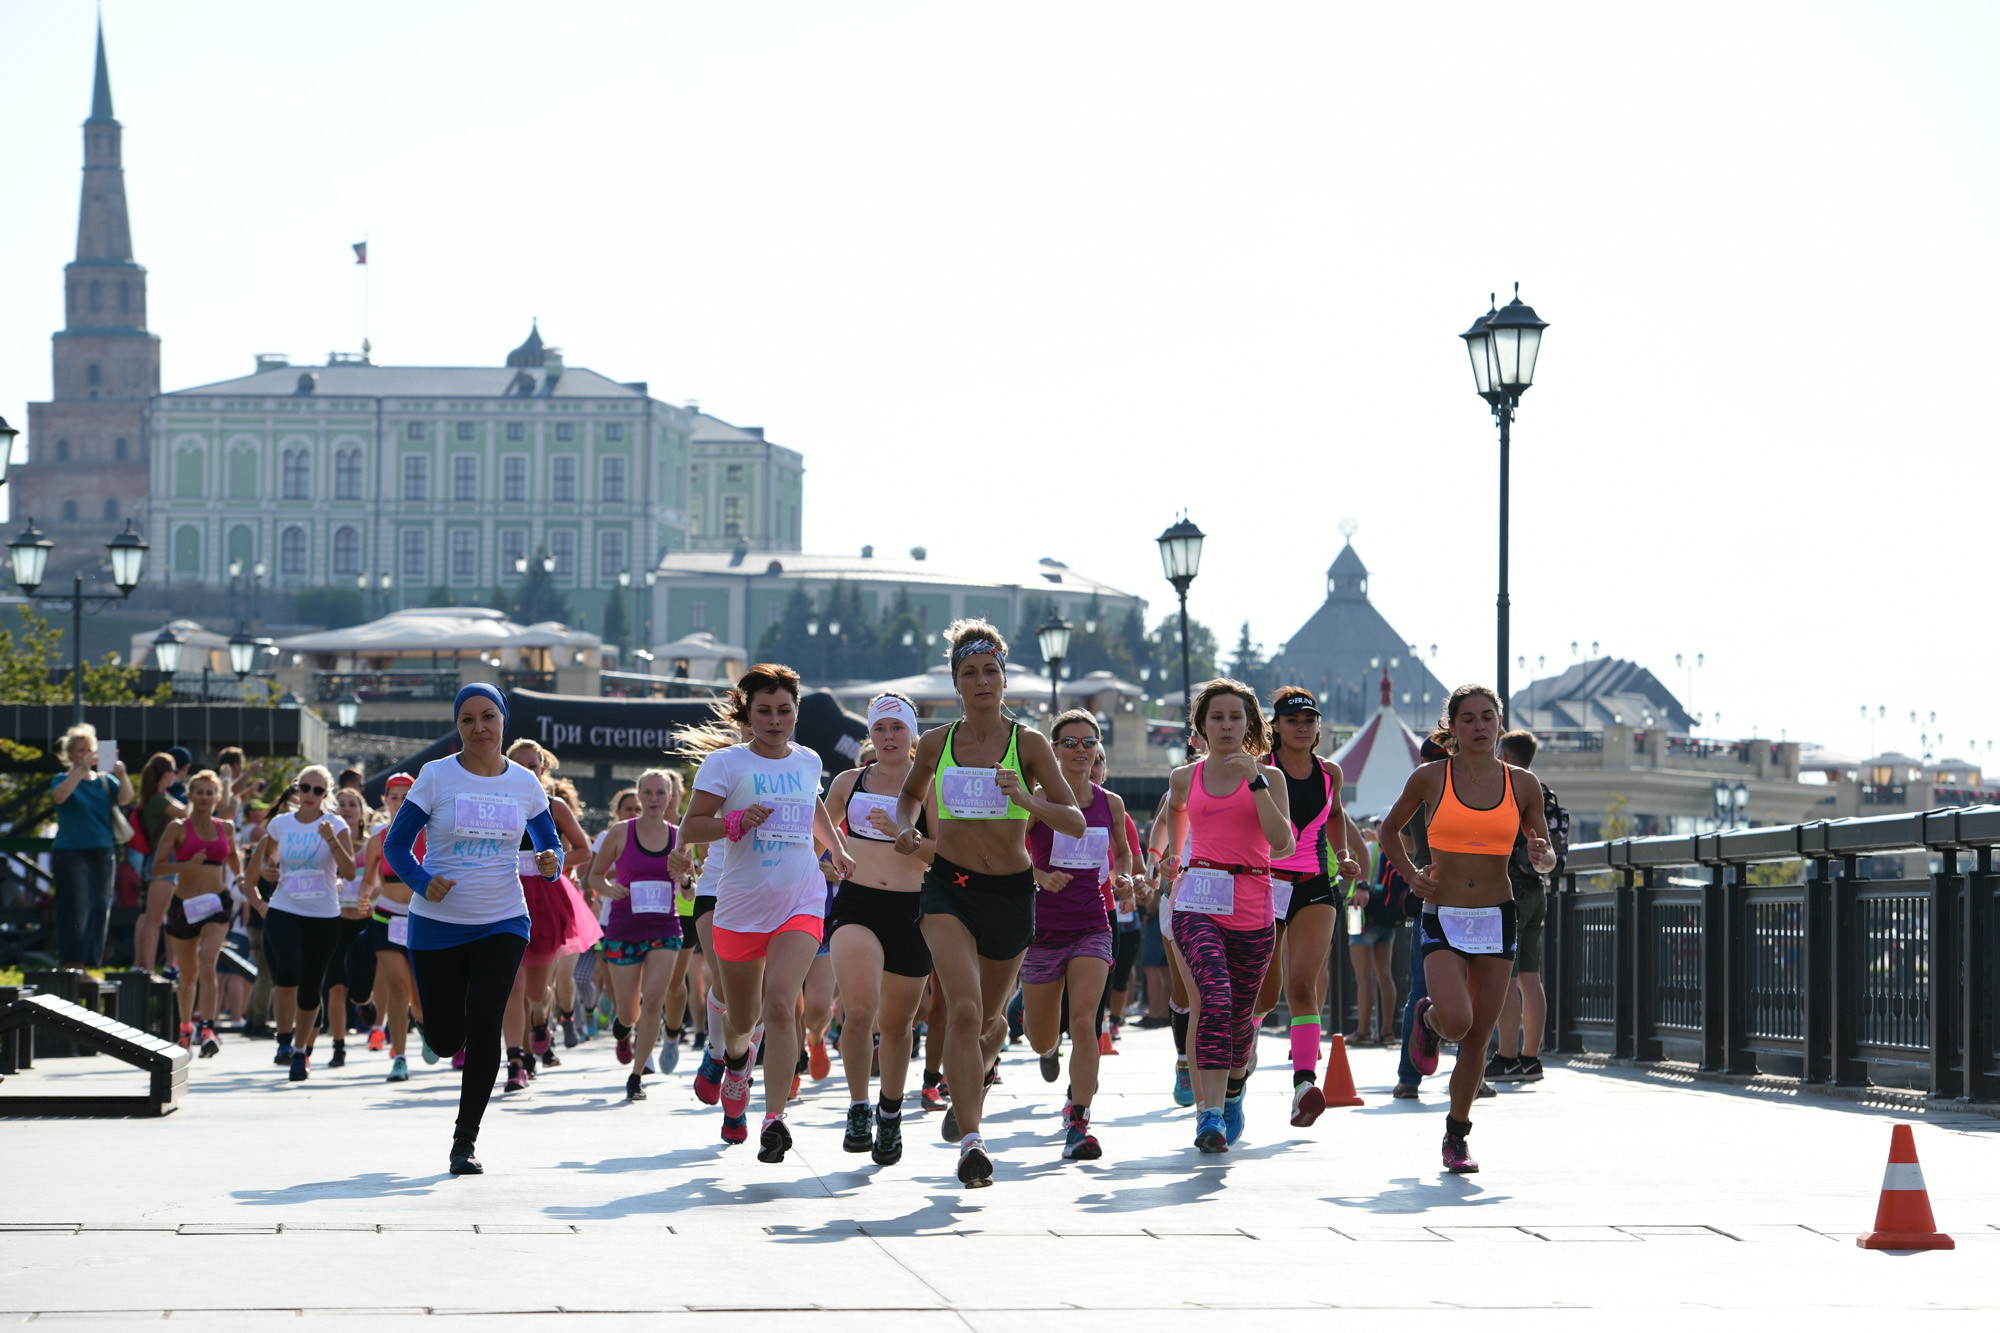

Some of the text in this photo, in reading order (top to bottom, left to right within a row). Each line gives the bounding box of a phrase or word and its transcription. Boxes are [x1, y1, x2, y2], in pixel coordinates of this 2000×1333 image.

[536, 715, 583, 749] Три
[753, 770, 803, 795] RUN
[963, 779, 984, 797] 49
[951, 798, 996, 807] ANASTASIYA
[478, 803, 496, 820] 52
[781, 804, 800, 822] 80
[469, 819, 504, 829] RAVILOVA
[770, 823, 808, 832] NADEZHDA
[287, 831, 320, 846] RUN
[1193, 877, 1211, 896] 30
[1186, 895, 1218, 904] VIOLETTA
[1465, 918, 1474, 935] 2
